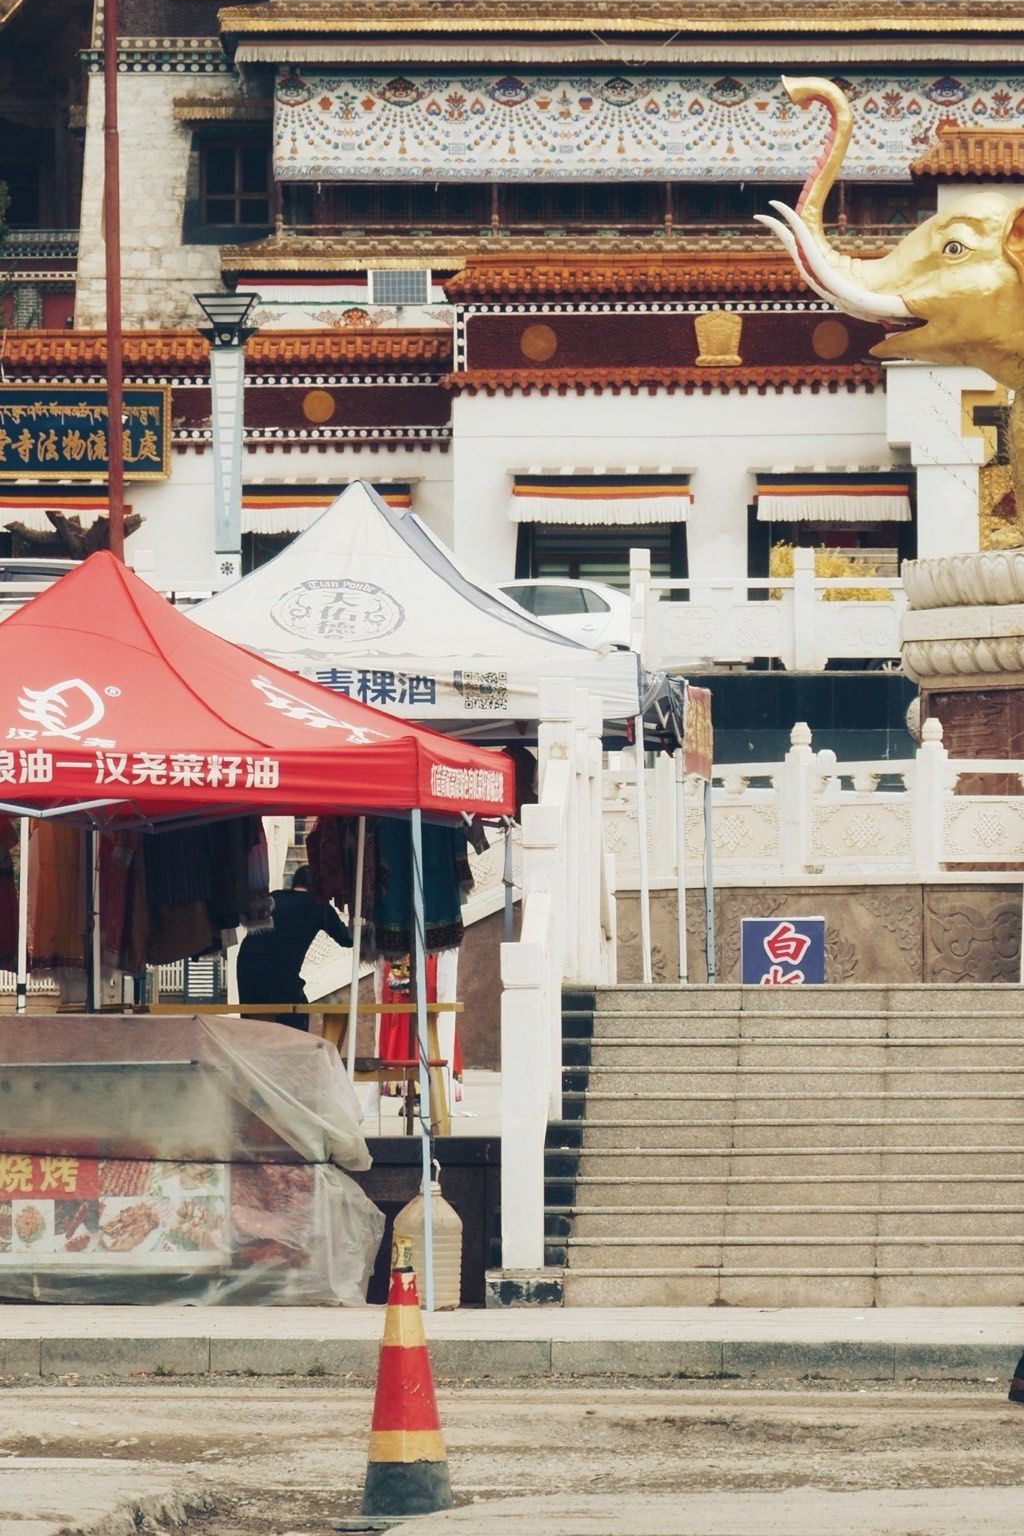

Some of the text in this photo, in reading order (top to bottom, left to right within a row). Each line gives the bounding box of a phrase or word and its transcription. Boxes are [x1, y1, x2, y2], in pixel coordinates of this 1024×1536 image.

[316, 668, 436, 705] 青稞酒
[0, 1155, 79, 1193] 烧烤
